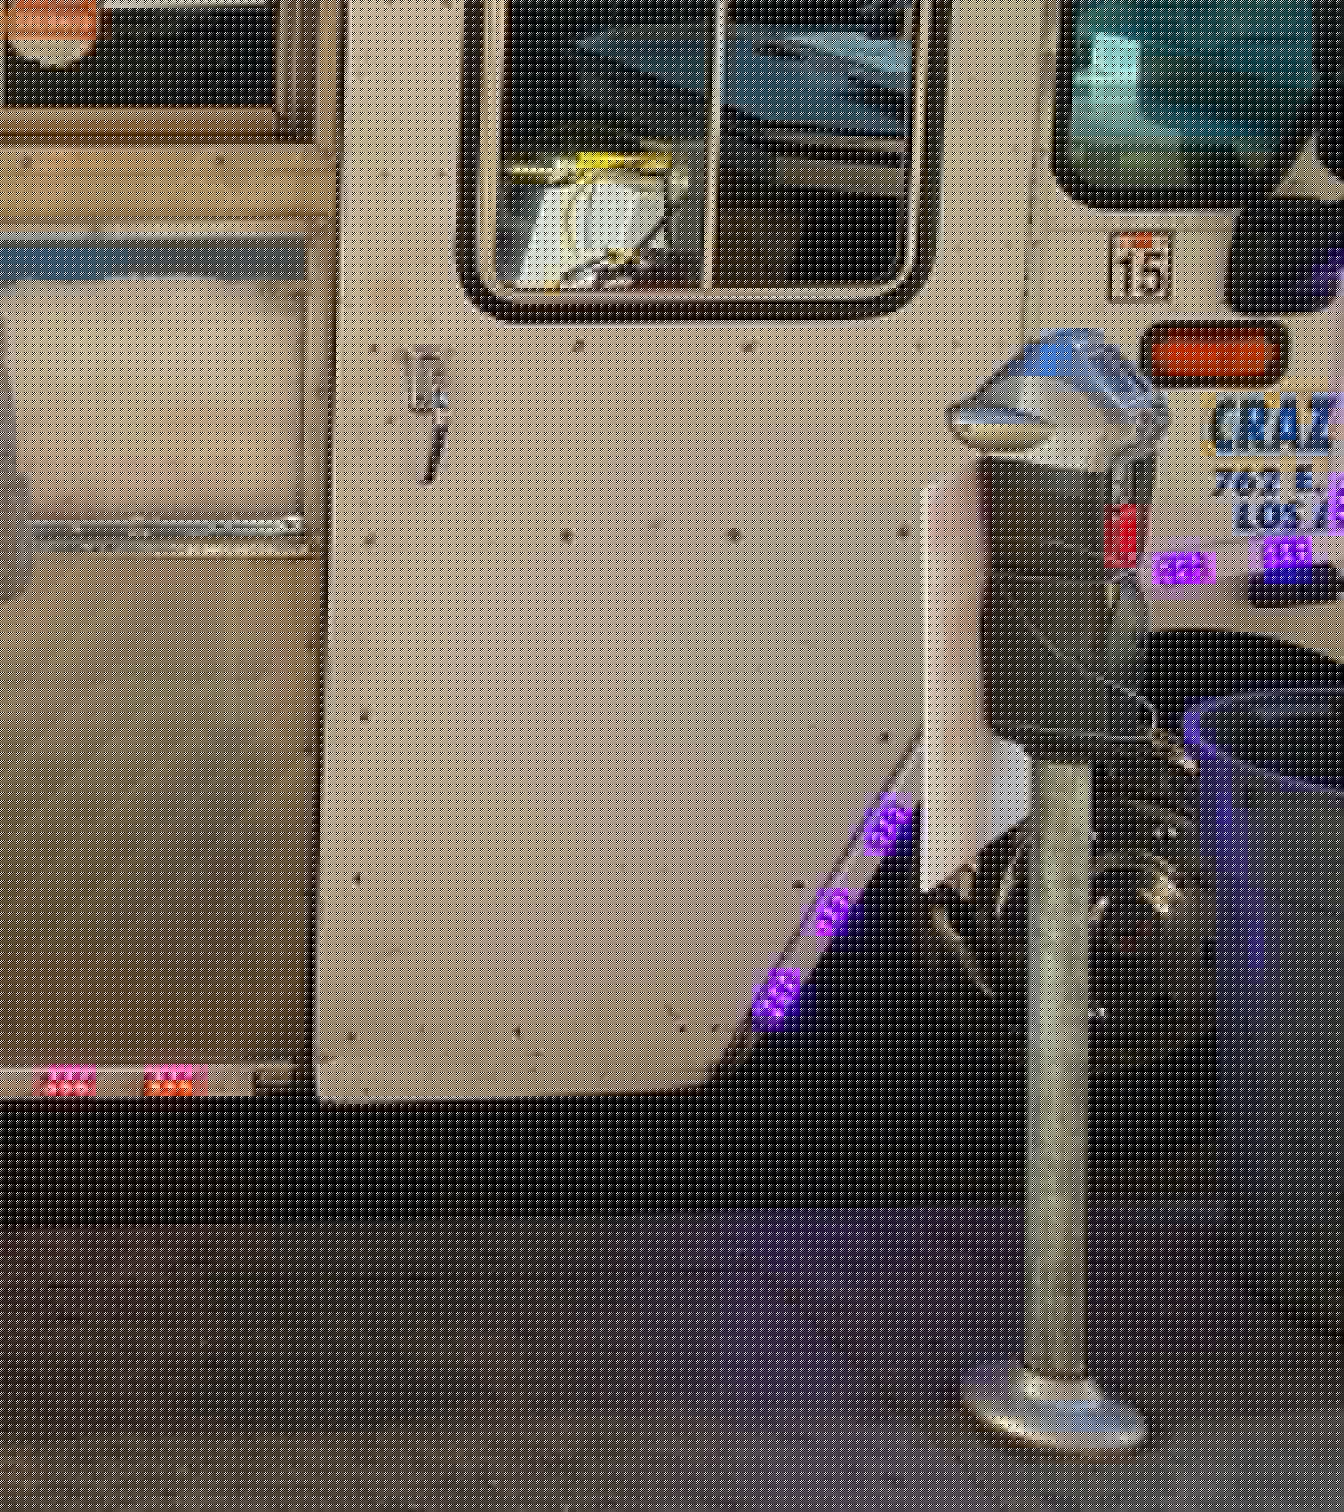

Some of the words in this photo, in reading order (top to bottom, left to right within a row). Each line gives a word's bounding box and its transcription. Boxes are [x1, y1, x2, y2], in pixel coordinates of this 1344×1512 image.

[1112, 248, 1165, 295] 15
[1208, 397, 1337, 454] CRAZ
[1210, 465, 1281, 497] 762
[1234, 499, 1305, 530] LOS
